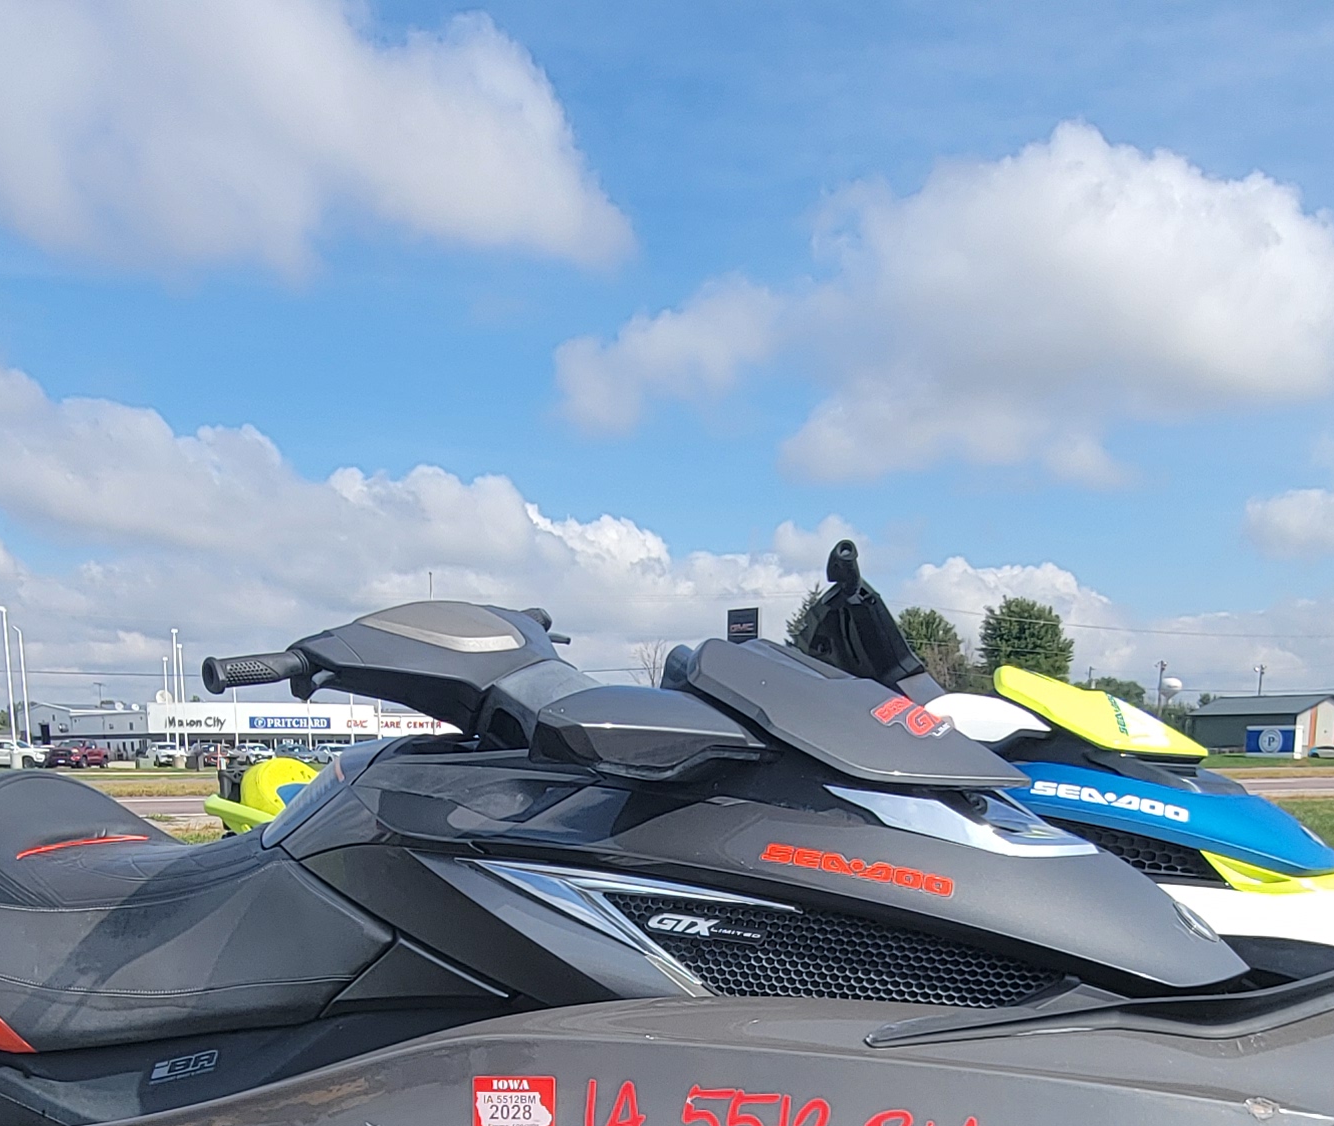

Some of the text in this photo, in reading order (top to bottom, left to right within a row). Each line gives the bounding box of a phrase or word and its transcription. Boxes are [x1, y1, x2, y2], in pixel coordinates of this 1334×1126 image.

[204, 716, 226, 731] City
[267, 718, 327, 728] PRITCHARD
[407, 721, 441, 729] CENTER
[647, 913, 762, 939] GTX LIMITED
[492, 1079, 530, 1090] IOWA
[483, 1095, 536, 1104] IA 5512BM
[489, 1104, 532, 1120] 2028
